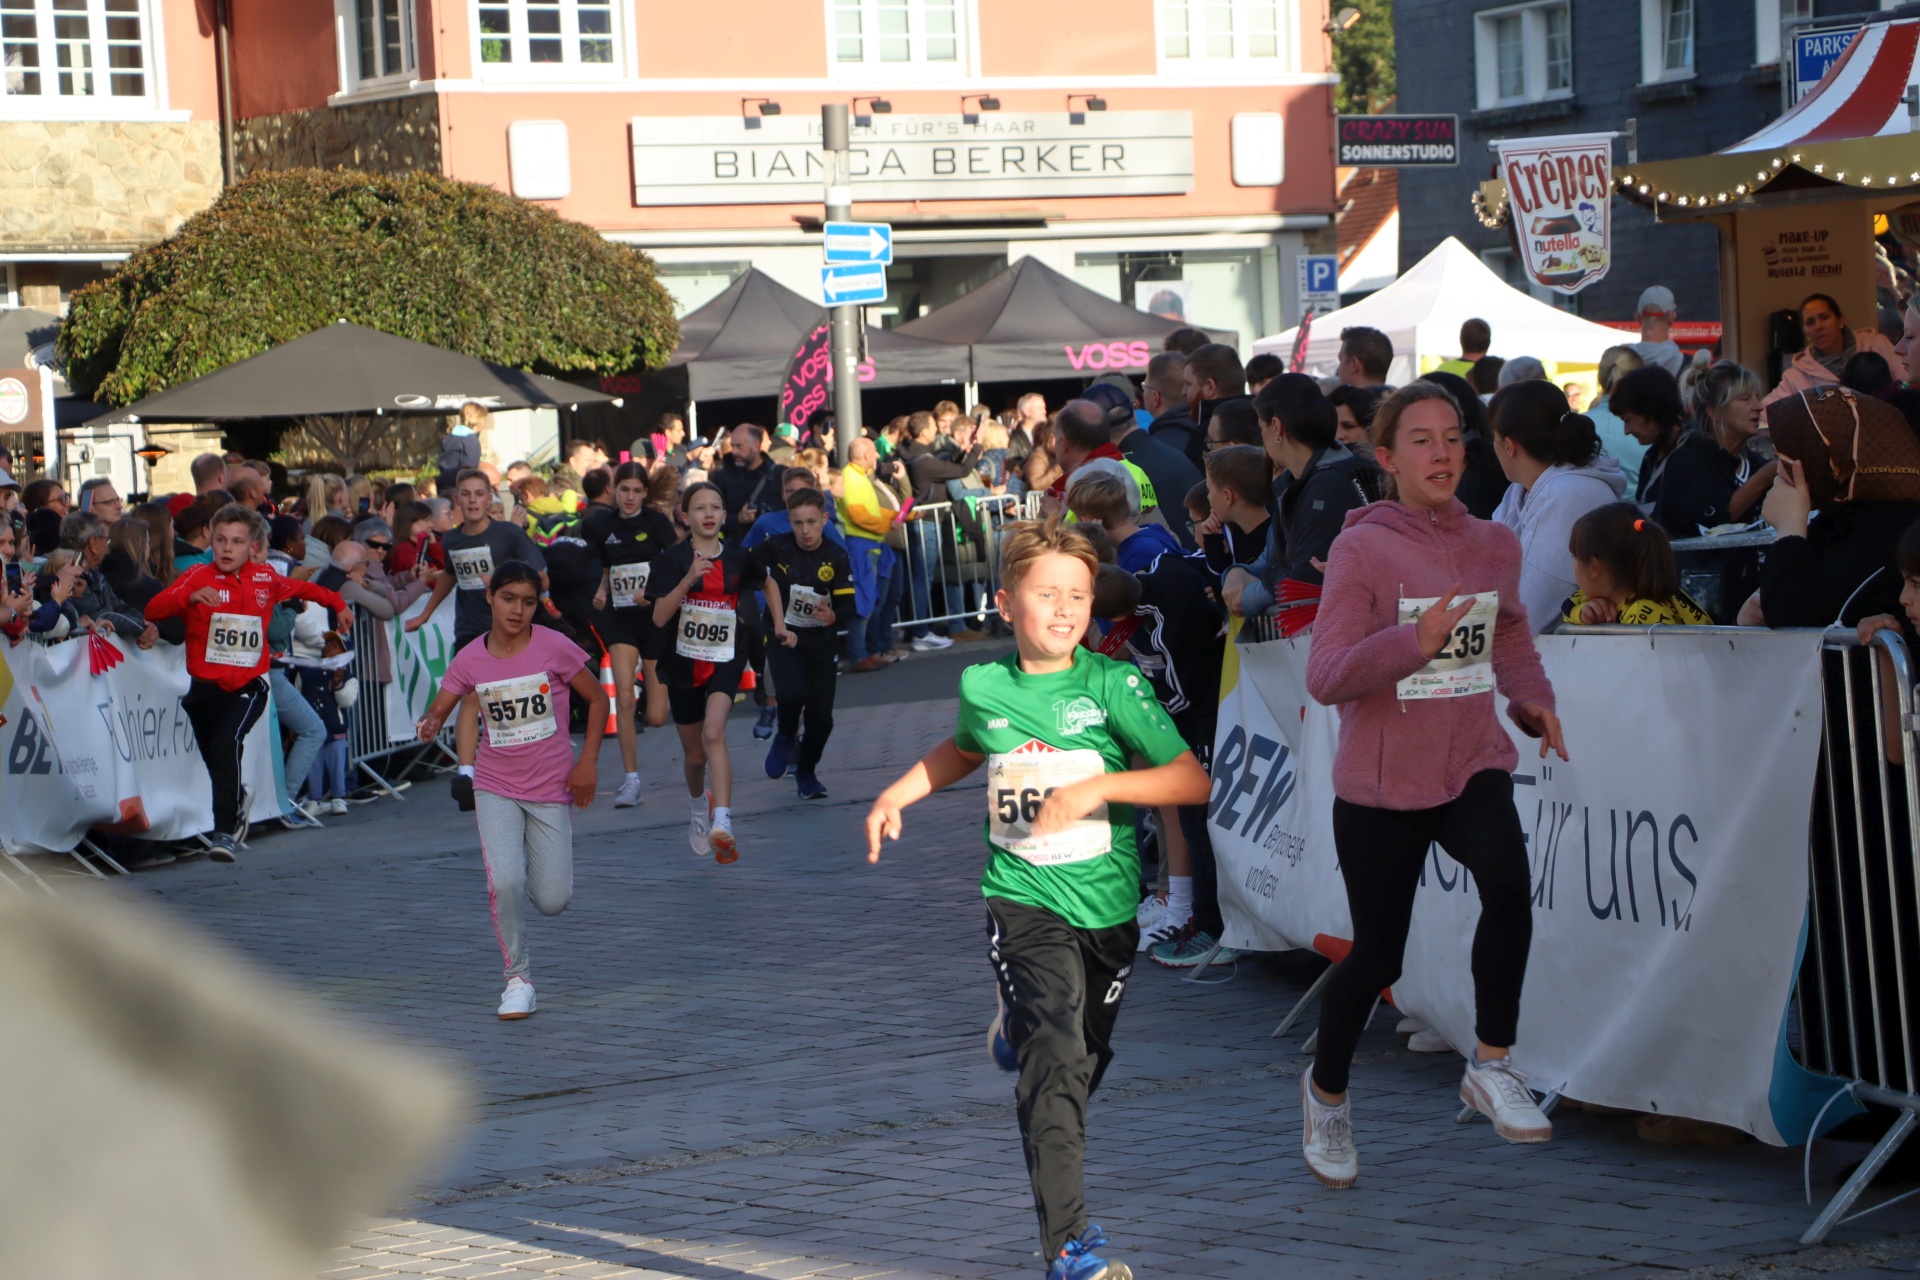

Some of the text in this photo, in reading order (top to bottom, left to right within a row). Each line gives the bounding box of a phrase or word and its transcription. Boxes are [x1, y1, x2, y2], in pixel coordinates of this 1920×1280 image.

[1806, 34, 1856, 57] PARKS
[1342, 121, 1454, 140] CRAZY SUN
[933, 144, 1126, 176] BERKER
[1342, 144, 1454, 160] SONNENSTUDIO
[1508, 151, 1608, 213] Crêpes
[1535, 233, 1580, 253] nutella
[1314, 262, 1330, 289] P
[1064, 340, 1150, 371] VOSS
[455, 559, 489, 576] 5619
[613, 575, 647, 591] 5172
[214, 628, 259, 648] 5610
[684, 621, 730, 642] 6095
[1430, 688, 1453, 696] VOSS
[1454, 686, 1470, 694] BEW
[488, 694, 547, 722] 5578
[998, 787, 1056, 824] 56
[1051, 852, 1073, 861] BEW
